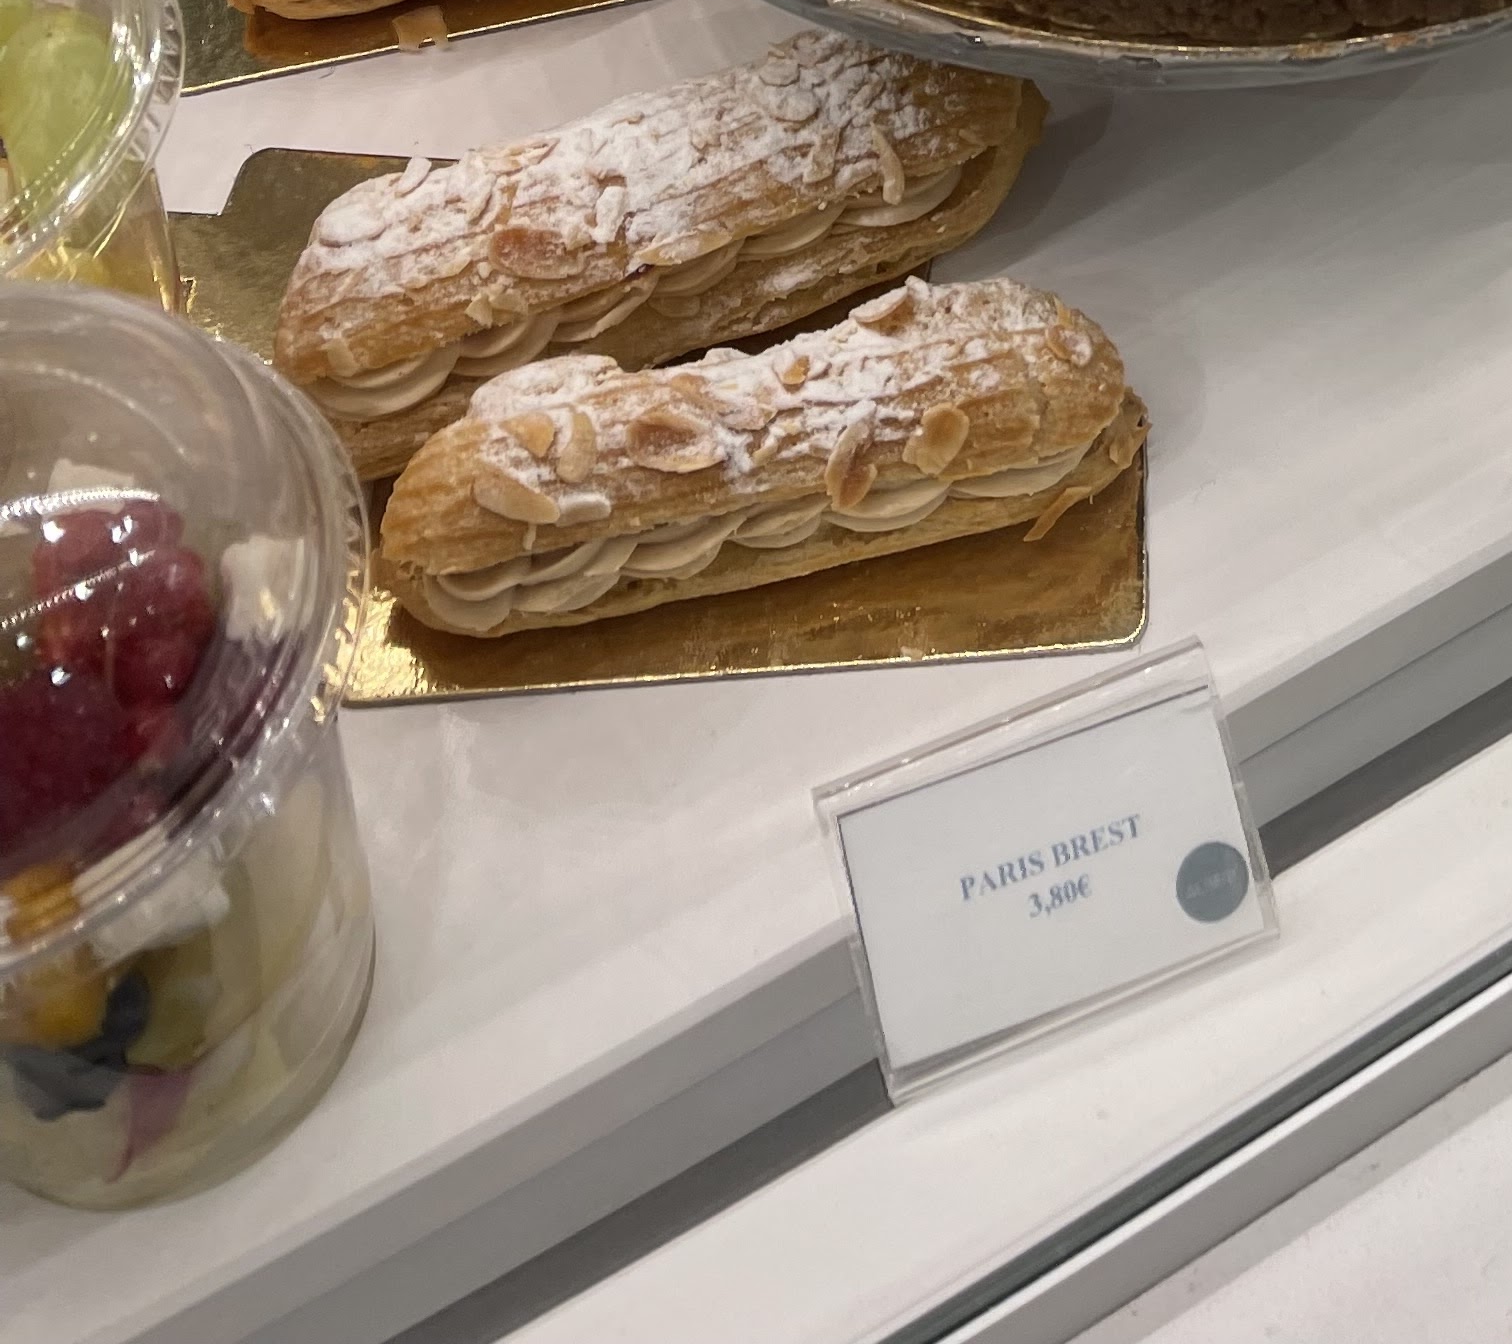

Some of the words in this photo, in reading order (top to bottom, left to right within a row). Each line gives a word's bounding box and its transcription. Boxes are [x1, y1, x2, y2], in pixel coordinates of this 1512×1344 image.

[960, 850, 1045, 901] PARIS
[1051, 813, 1141, 868] BREST
[1028, 873, 1092, 918] 3,80€
